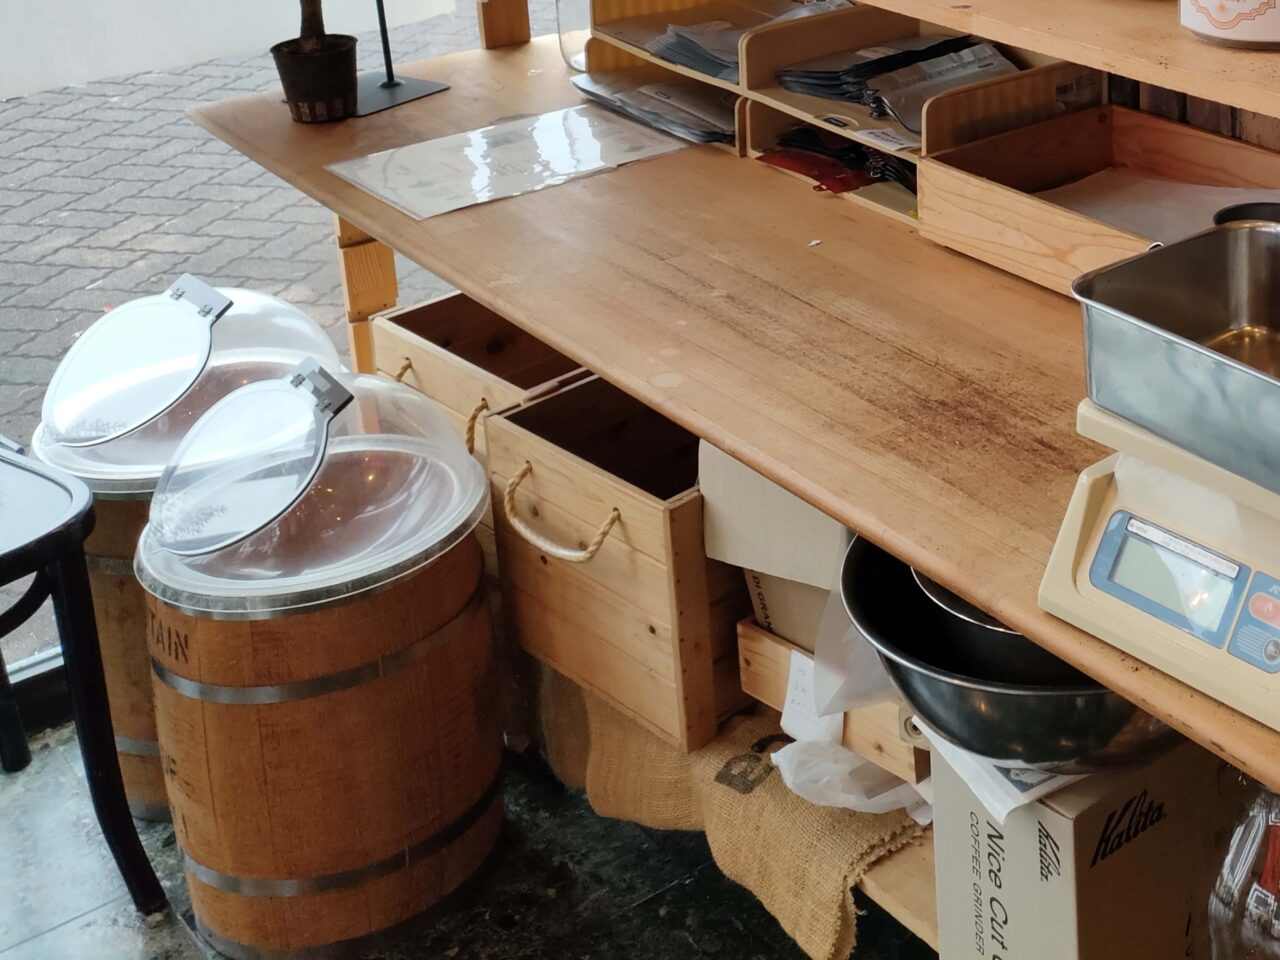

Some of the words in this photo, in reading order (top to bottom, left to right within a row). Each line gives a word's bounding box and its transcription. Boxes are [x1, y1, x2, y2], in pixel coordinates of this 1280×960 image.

[969, 811, 982, 881] COFFEE
[986, 819, 1005, 890] Nice
[1037, 819, 1062, 883] Kalita
[1089, 789, 1168, 869] Kalita
[972, 882, 985, 956] GRINDER
[989, 896, 1009, 952] Cut
